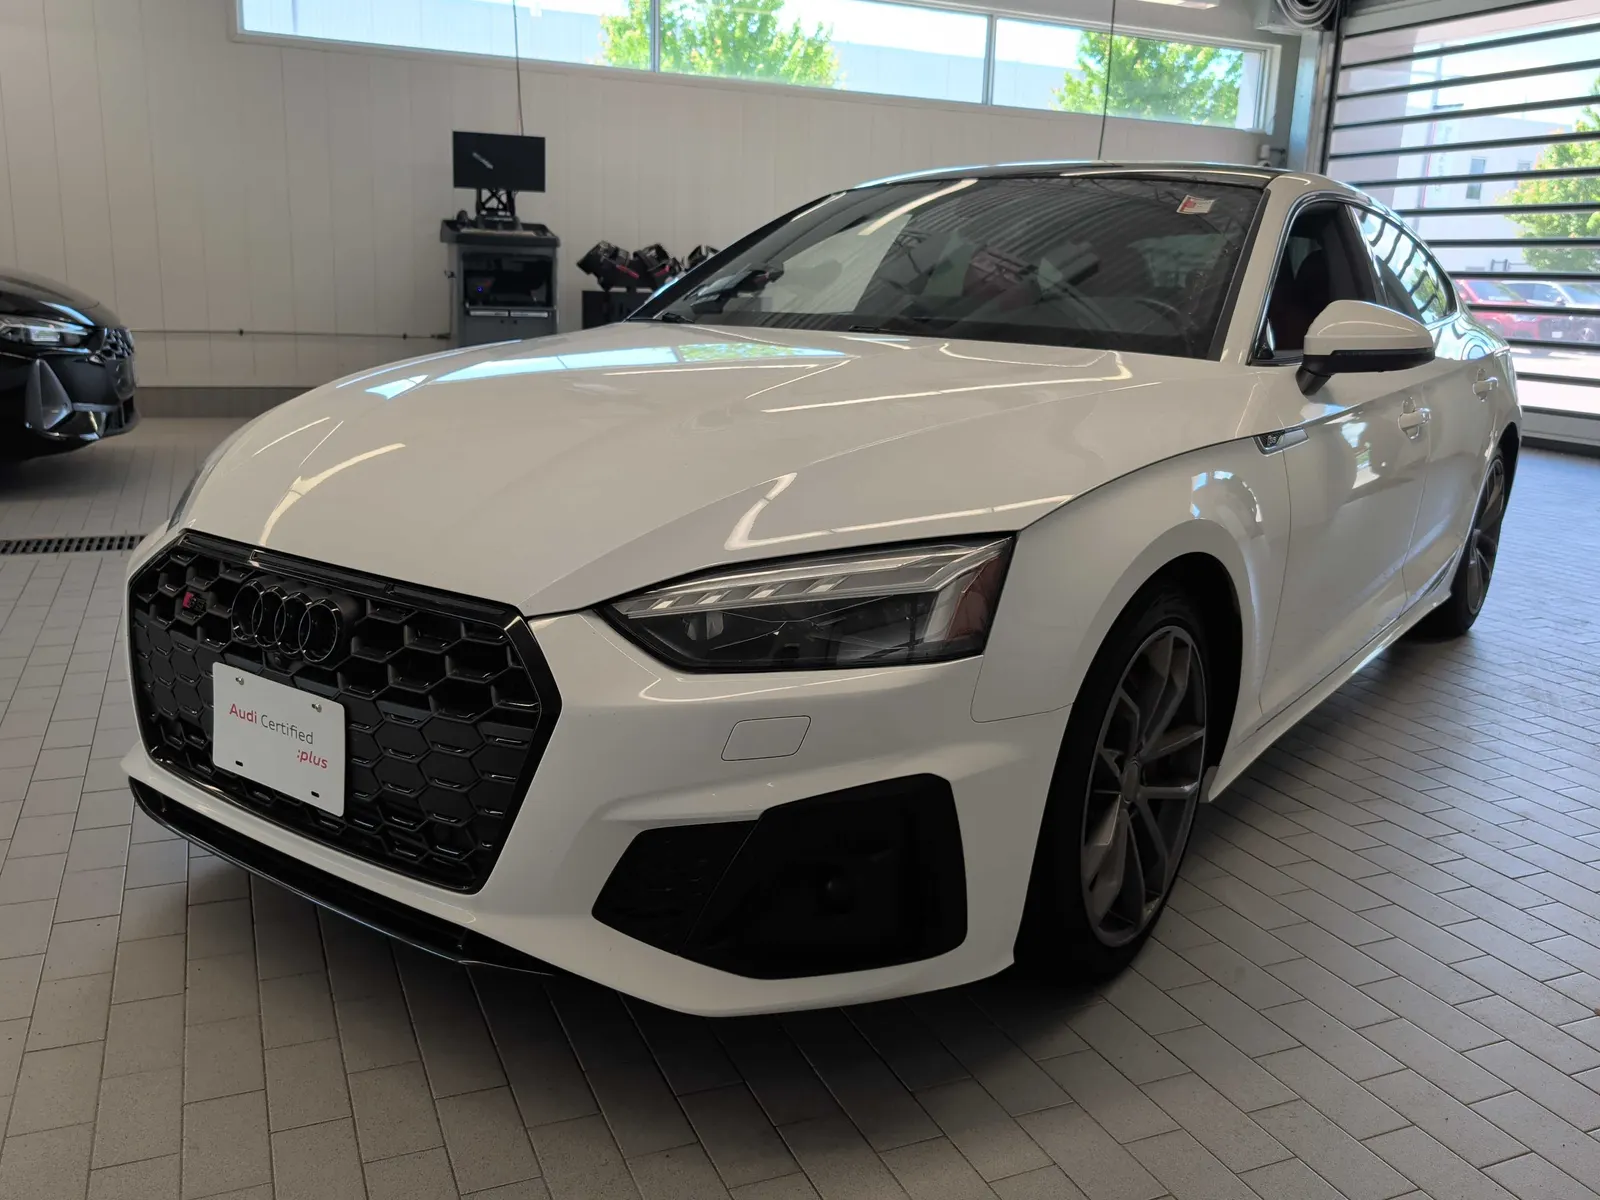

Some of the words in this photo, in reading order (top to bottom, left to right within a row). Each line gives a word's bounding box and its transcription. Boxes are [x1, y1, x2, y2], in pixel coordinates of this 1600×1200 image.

[229, 703, 257, 724] Audi
[261, 714, 314, 744] Certified
[297, 749, 328, 769] :plus
